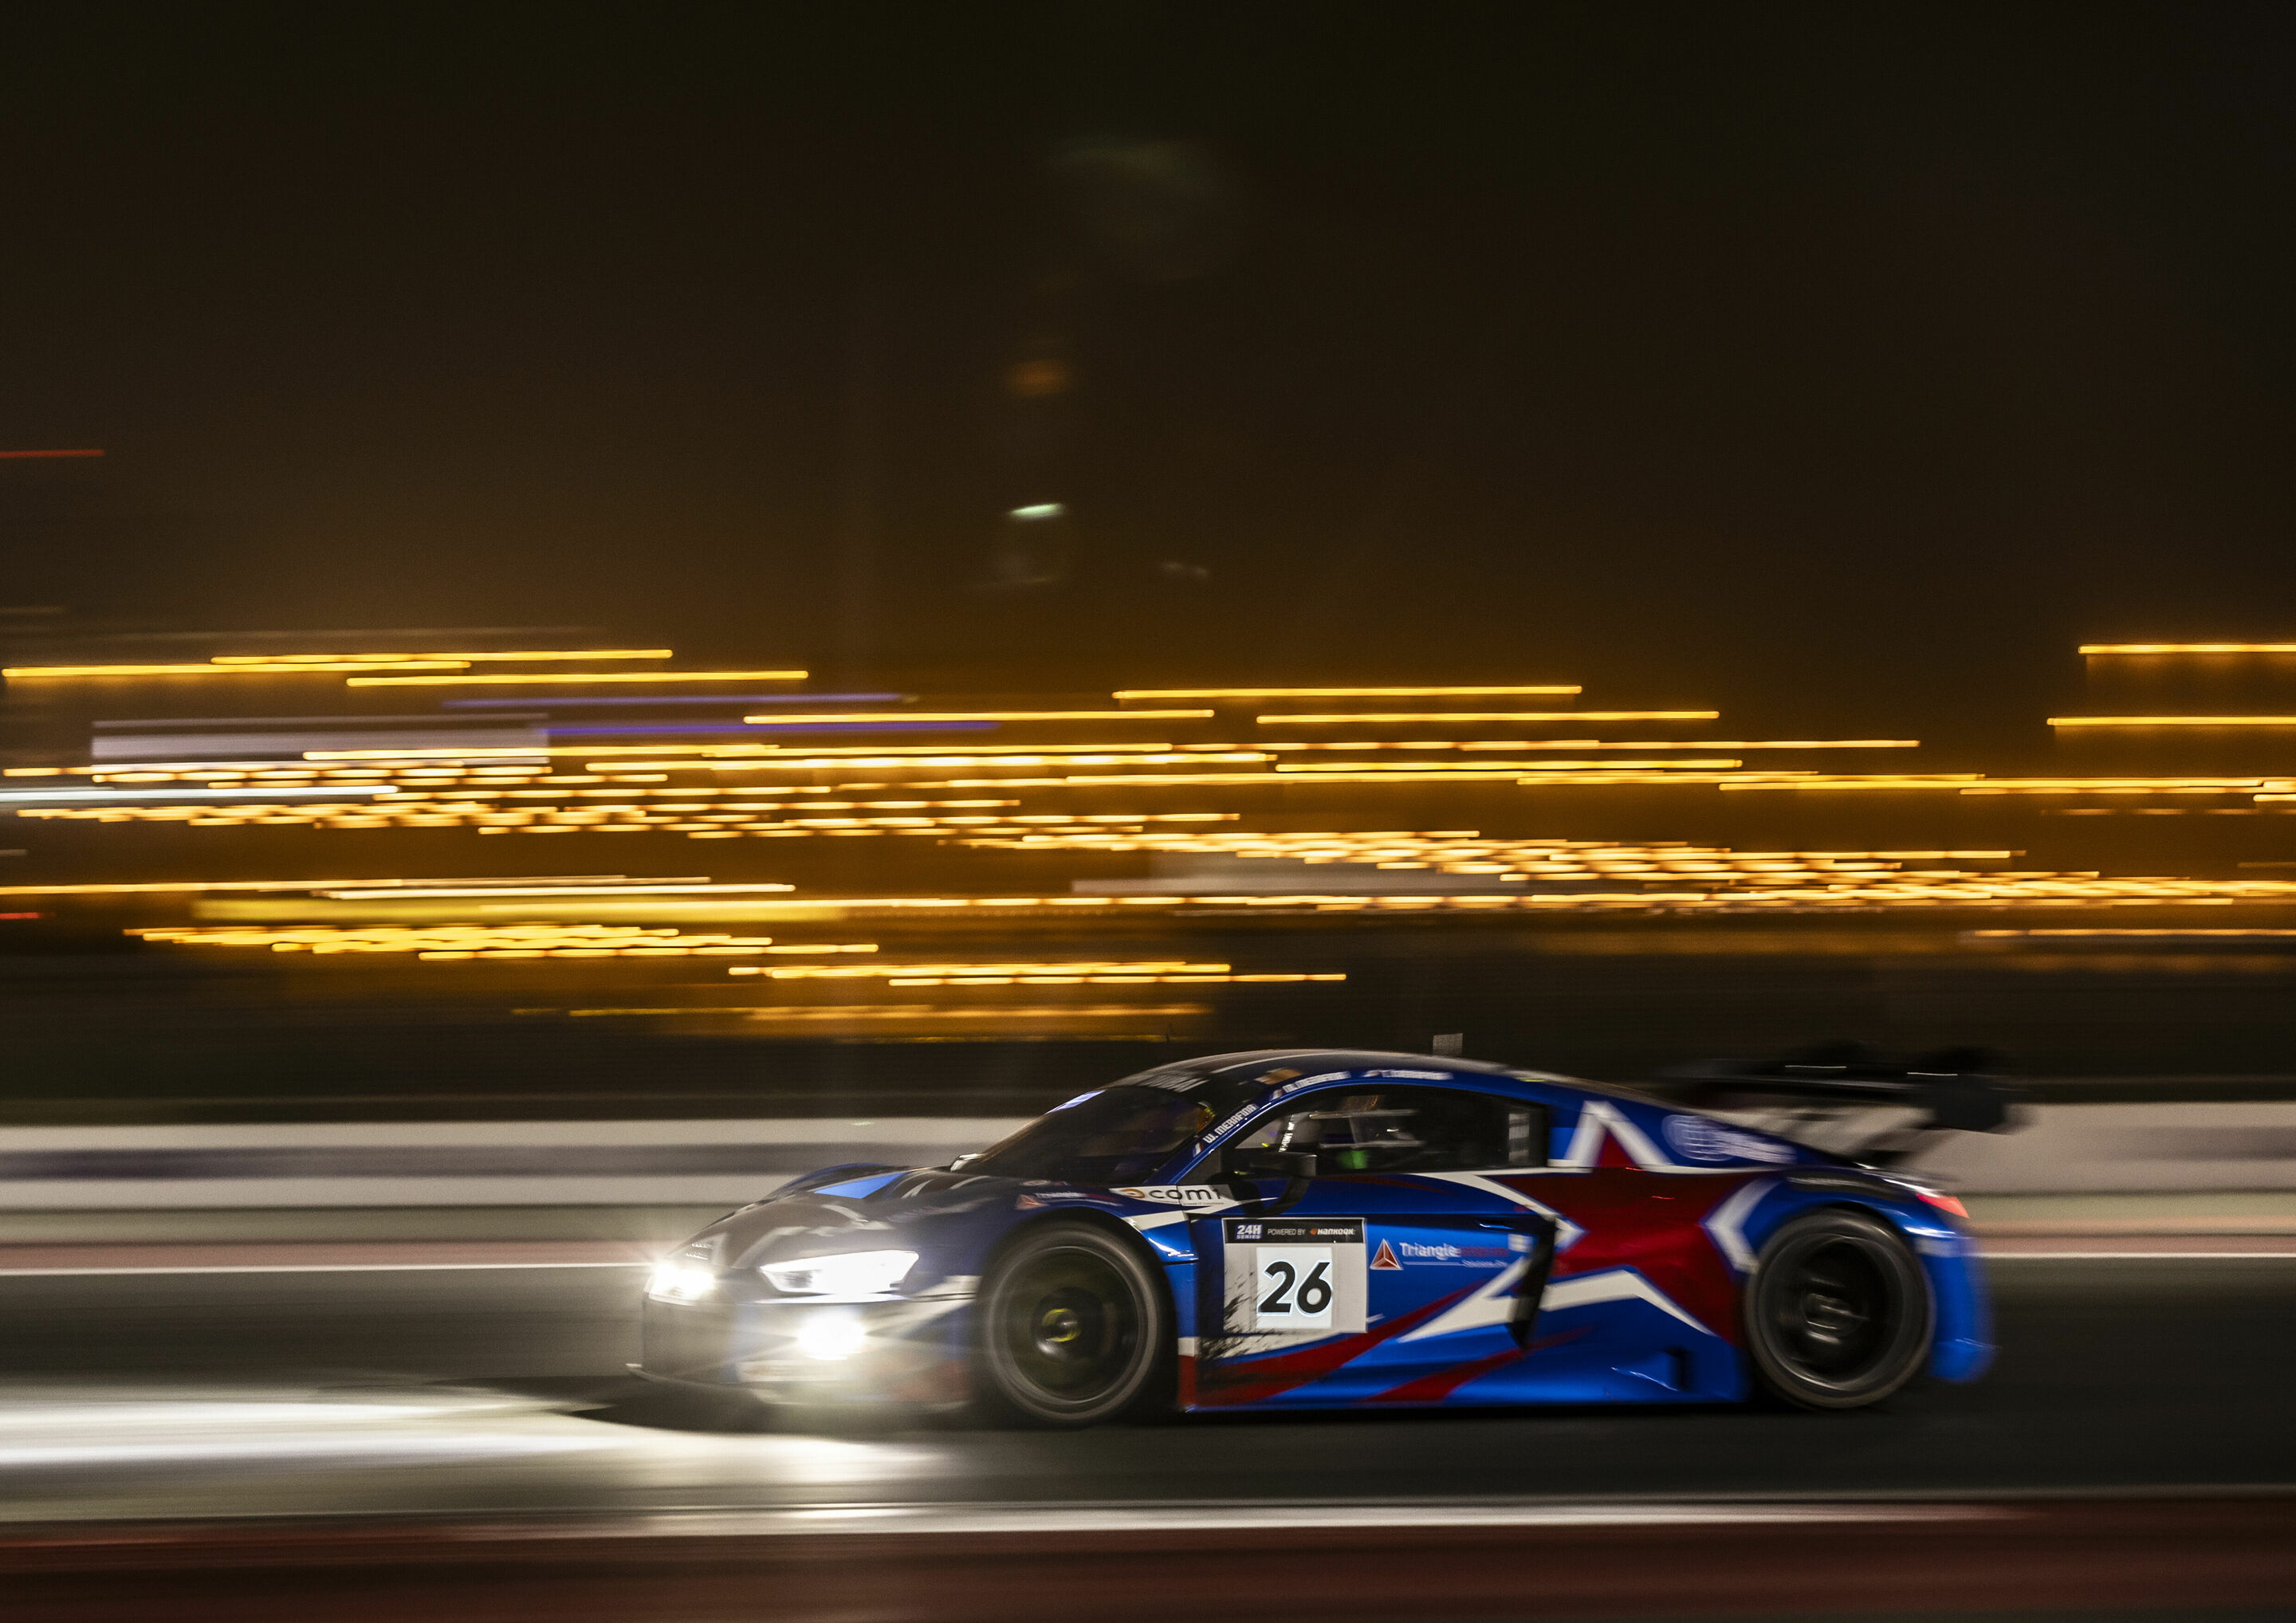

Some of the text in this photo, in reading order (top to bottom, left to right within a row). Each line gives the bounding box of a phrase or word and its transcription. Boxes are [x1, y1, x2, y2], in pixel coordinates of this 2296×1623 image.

[1236, 1224, 1263, 1235] 24H
[1399, 1242, 1461, 1260] Triangle
[1257, 1260, 1332, 1315] 26
